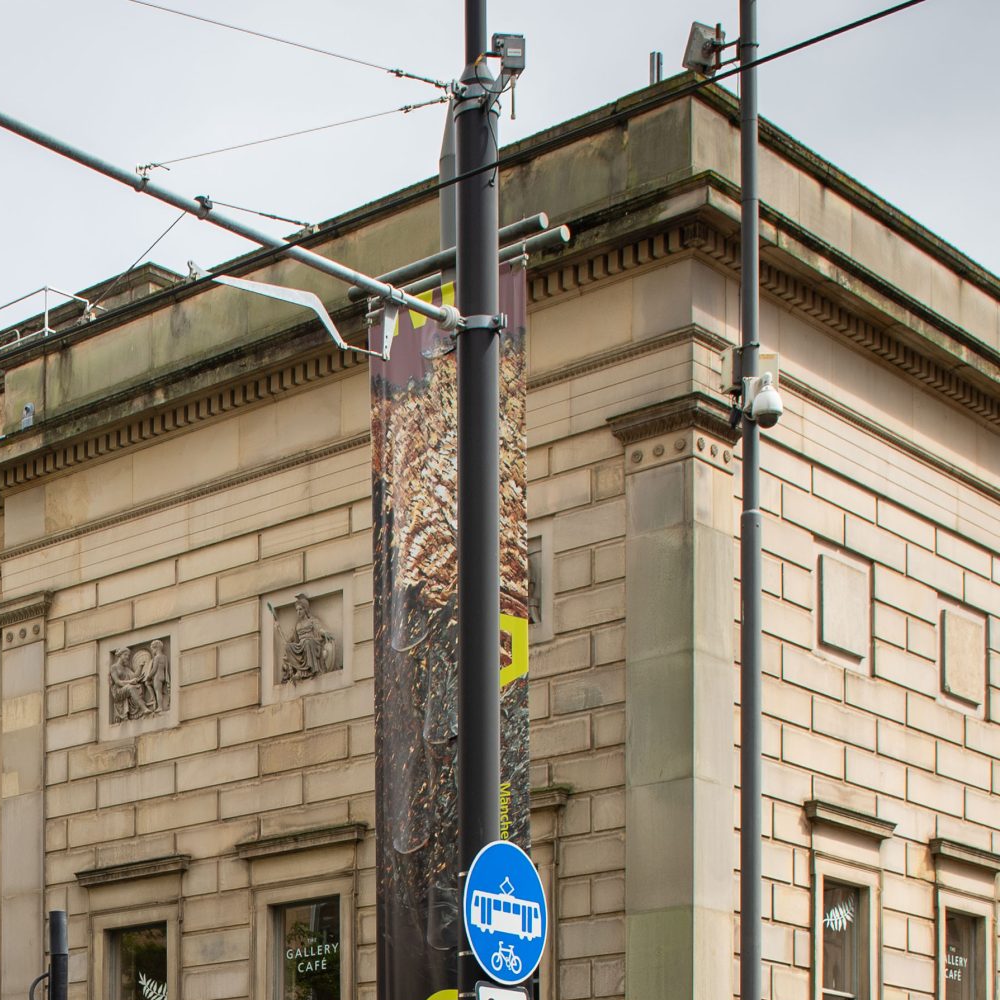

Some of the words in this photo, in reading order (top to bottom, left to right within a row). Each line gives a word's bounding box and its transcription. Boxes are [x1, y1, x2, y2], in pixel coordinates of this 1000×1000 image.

[500, 782, 512, 840] Manche
[286, 942, 339, 960] GALLERY
[297, 957, 327, 973] CAFÉ
[945, 954, 967, 967] LLERY
